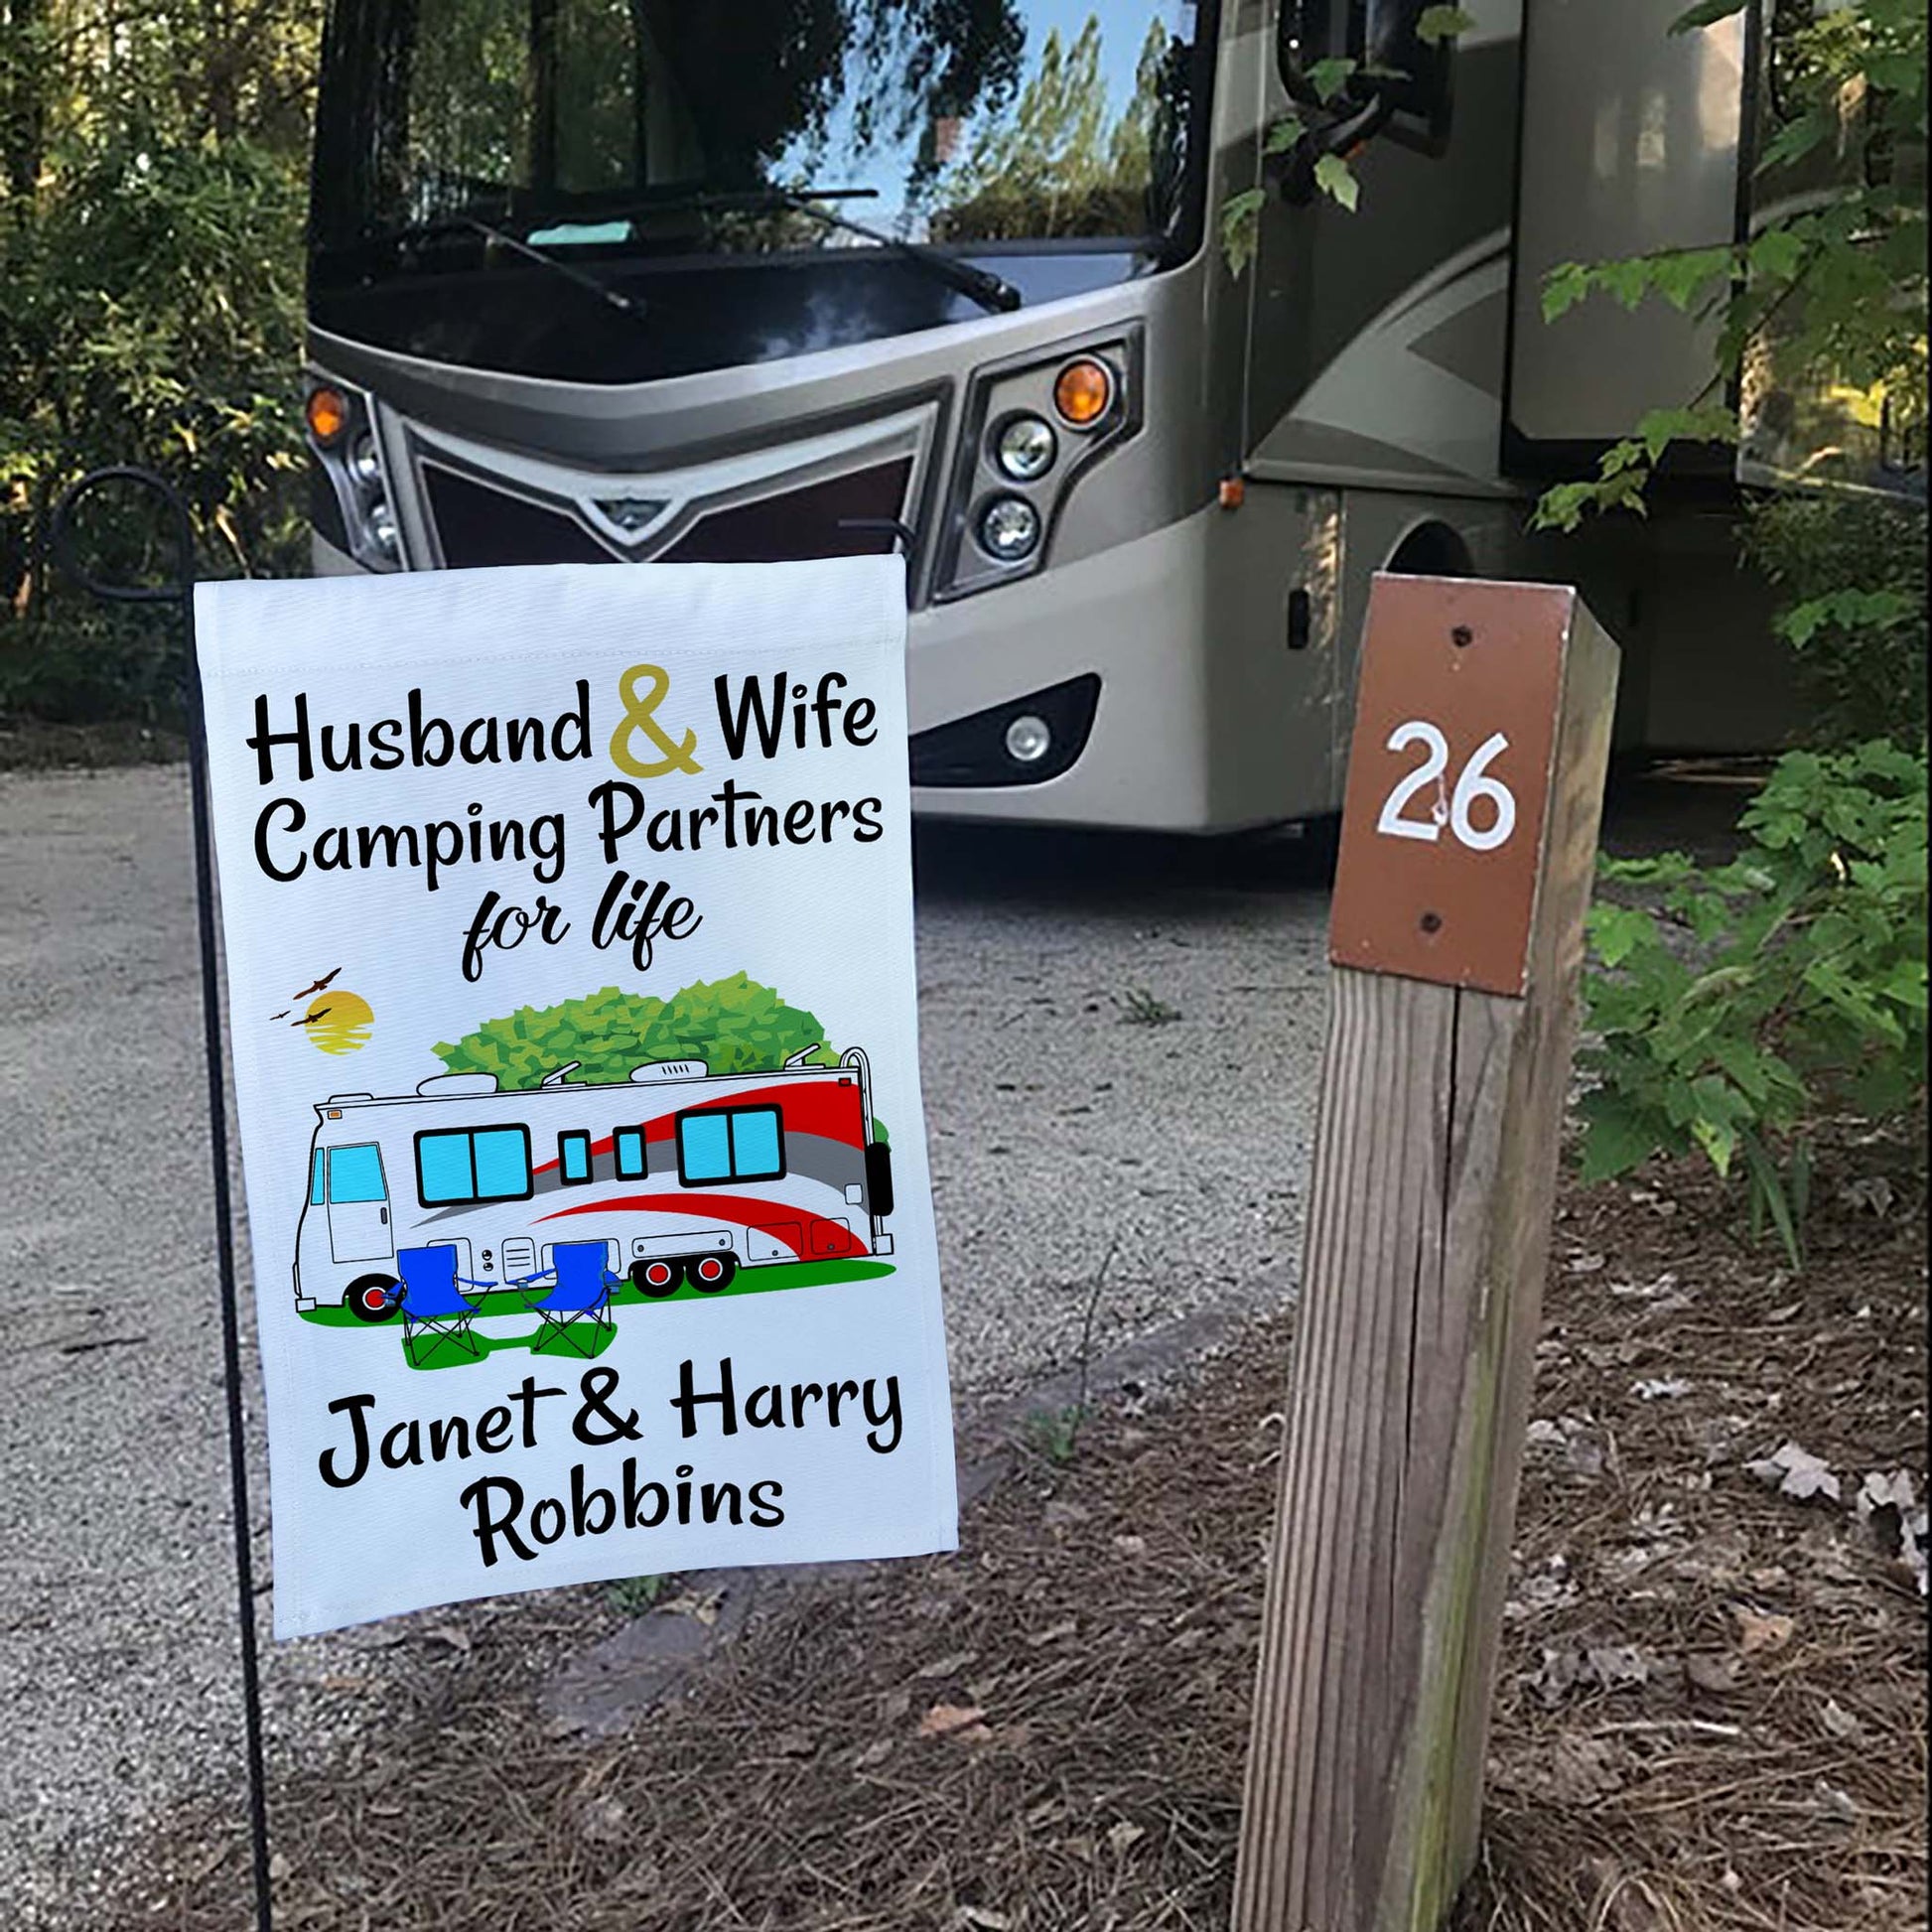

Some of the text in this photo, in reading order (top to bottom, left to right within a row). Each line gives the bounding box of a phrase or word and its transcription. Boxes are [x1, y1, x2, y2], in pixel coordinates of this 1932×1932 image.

[246, 664, 878, 784] Husband & Wife
[255, 779, 883, 892] Camping Partners
[1378, 722, 1515, 850] 26
[463, 871, 703, 982] for life
[319, 1357, 901, 1487] Janet & Harry
[461, 1457, 784, 1567] Robbins
